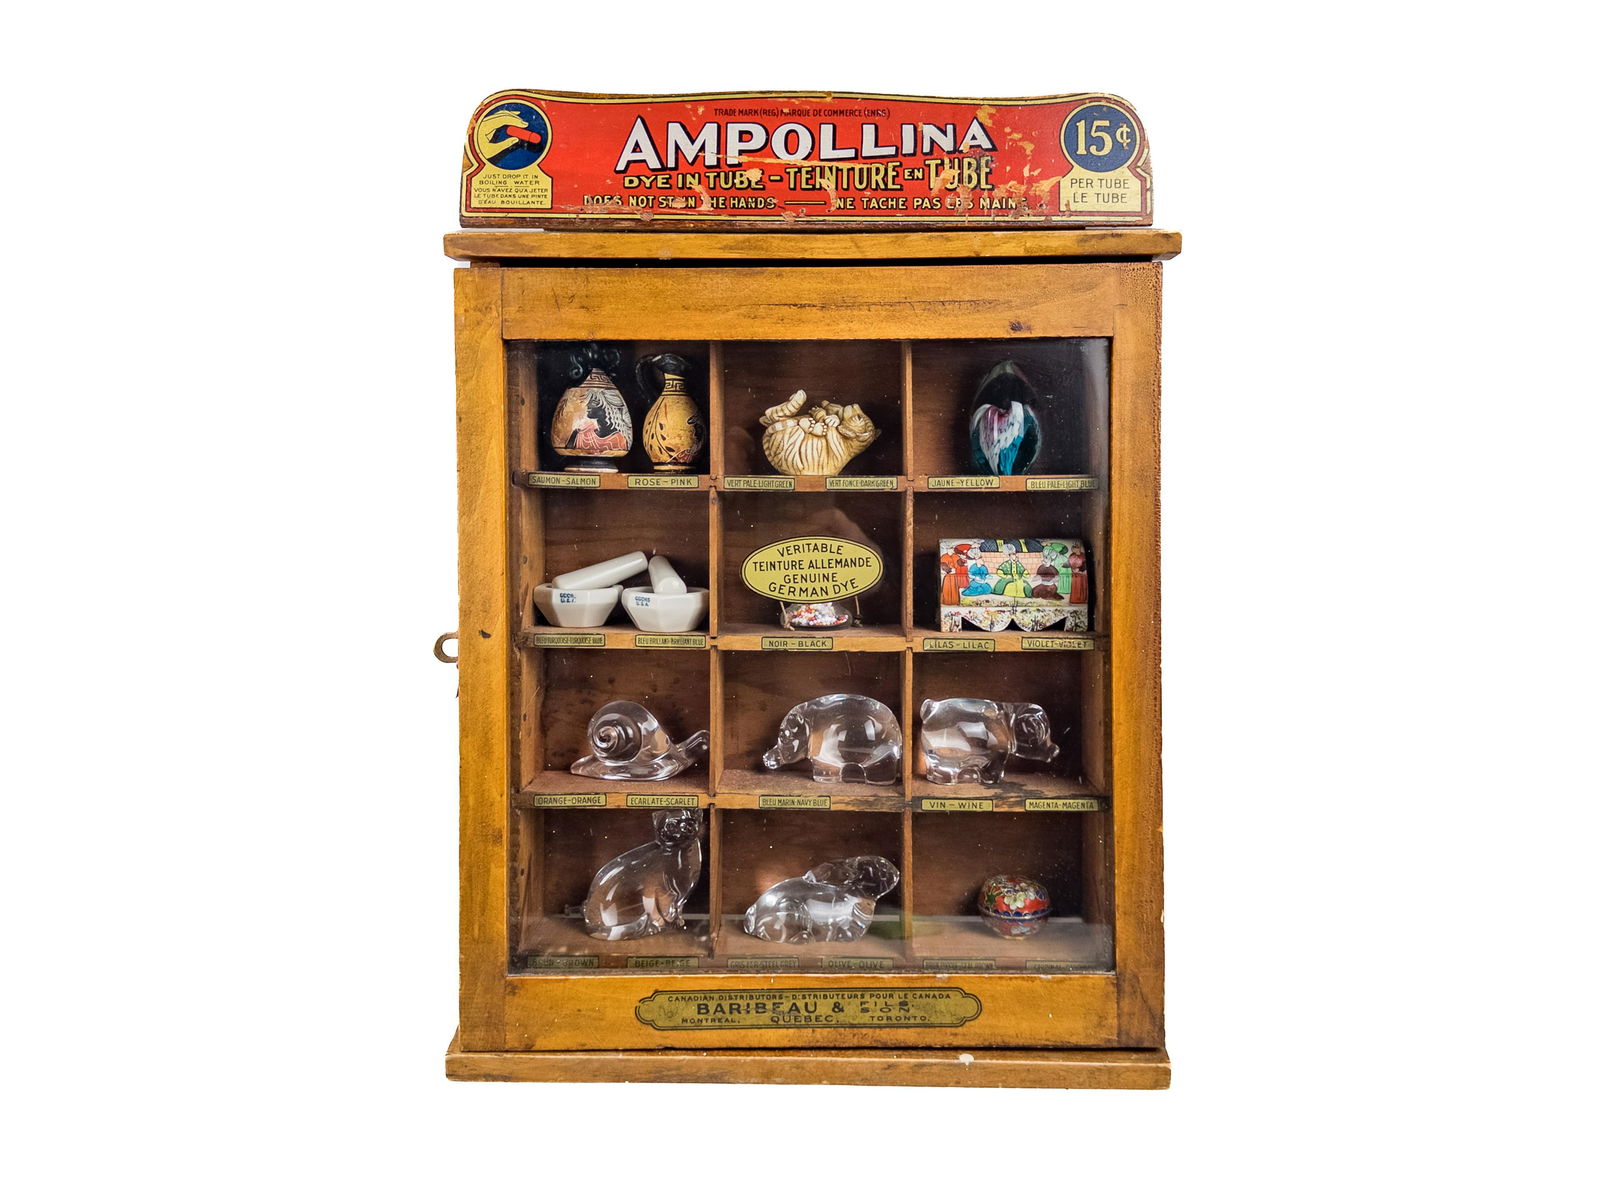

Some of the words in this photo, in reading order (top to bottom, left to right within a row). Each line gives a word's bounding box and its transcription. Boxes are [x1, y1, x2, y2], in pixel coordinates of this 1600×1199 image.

[714, 108, 736, 116] TRADE
[738, 108, 759, 116] MARK
[780, 108, 810, 117] MARQUE
[812, 108, 821, 117] DE
[823, 108, 862, 117] COMMERCE
[615, 115, 997, 172] AMPOLLINA
[1076, 119, 1131, 156] 15¢
[623, 175, 671, 188] DYE
[677, 173, 700, 188] IN
[706, 169, 764, 189] TUBE
[786, 161, 902, 190] TEINTURE
[904, 168, 923, 180] EN
[925, 155, 993, 189] TUBE
[1070, 179, 1094, 189] PER
[1097, 179, 1130, 189] TUBE
[629, 196, 655, 207] NOT
[730, 197, 776, 209] HANDS
[836, 198, 855, 209] NE
[861, 197, 907, 209] TACHE
[913, 197, 941, 209] PAS
[1073, 193, 1088, 203] LE
[1095, 193, 1128, 203] TUBE
[777, 543, 844, 557] VERITABLE
[752, 559, 805, 571] TEINTURE
[808, 557, 872, 569] ALLEMANDE
[783, 572, 838, 584] GENUINE
[768, 581, 829, 597] GERMAN
[832, 578, 859, 595] DYE
[697, 1001, 818, 1015] BARIBEAU
[831, 1001, 845, 1013] &
